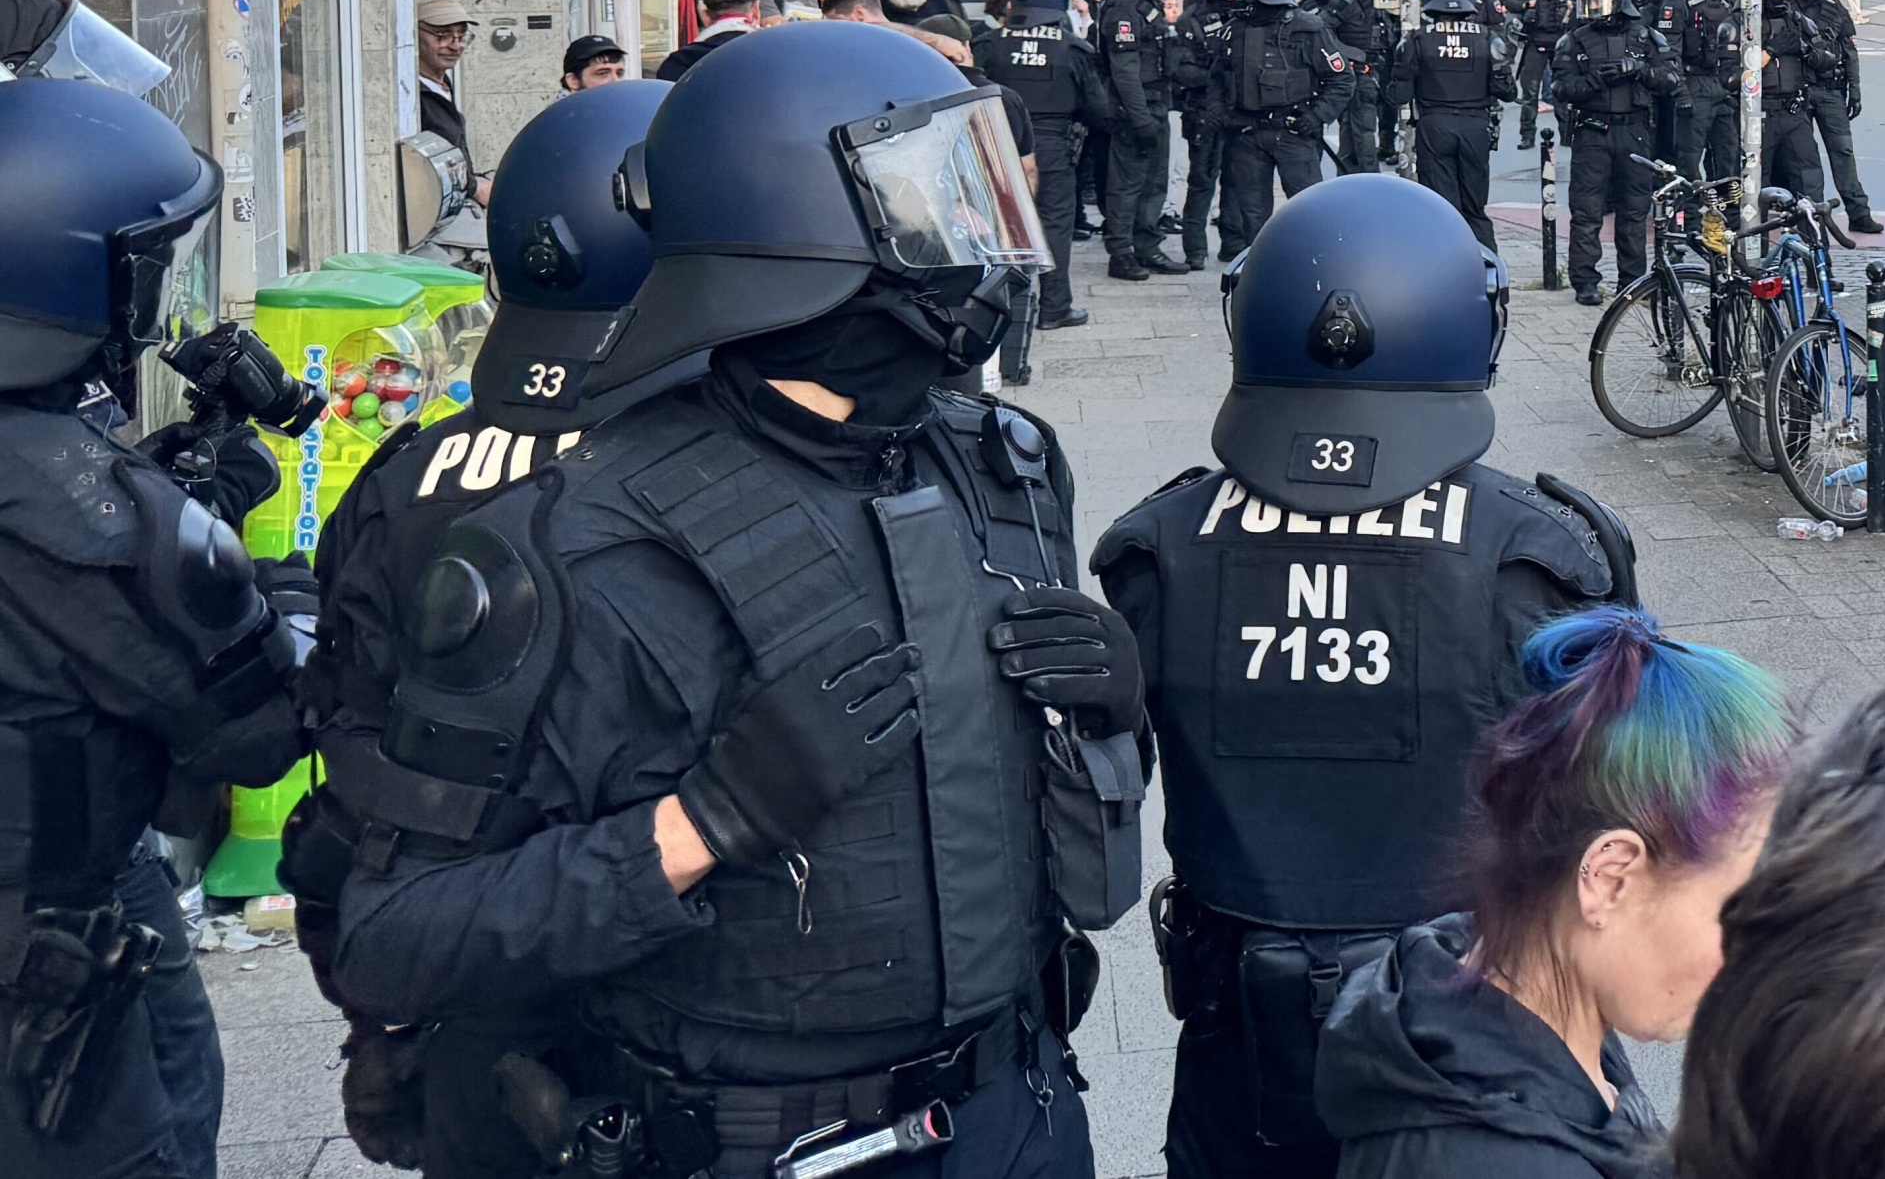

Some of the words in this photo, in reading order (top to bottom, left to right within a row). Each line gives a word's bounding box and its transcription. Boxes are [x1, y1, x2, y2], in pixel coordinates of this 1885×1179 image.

[1426, 21, 1481, 34] POLIZEI
[1022, 40, 1038, 53] NI
[1446, 35, 1460, 47] NI
[1011, 52, 1047, 66] 7126
[1437, 46, 1469, 59] 7125
[523, 363, 566, 398] 33
[1311, 438, 1355, 472] 33
[1287, 563, 1348, 620] NI
[1241, 626, 1391, 685] 7133
